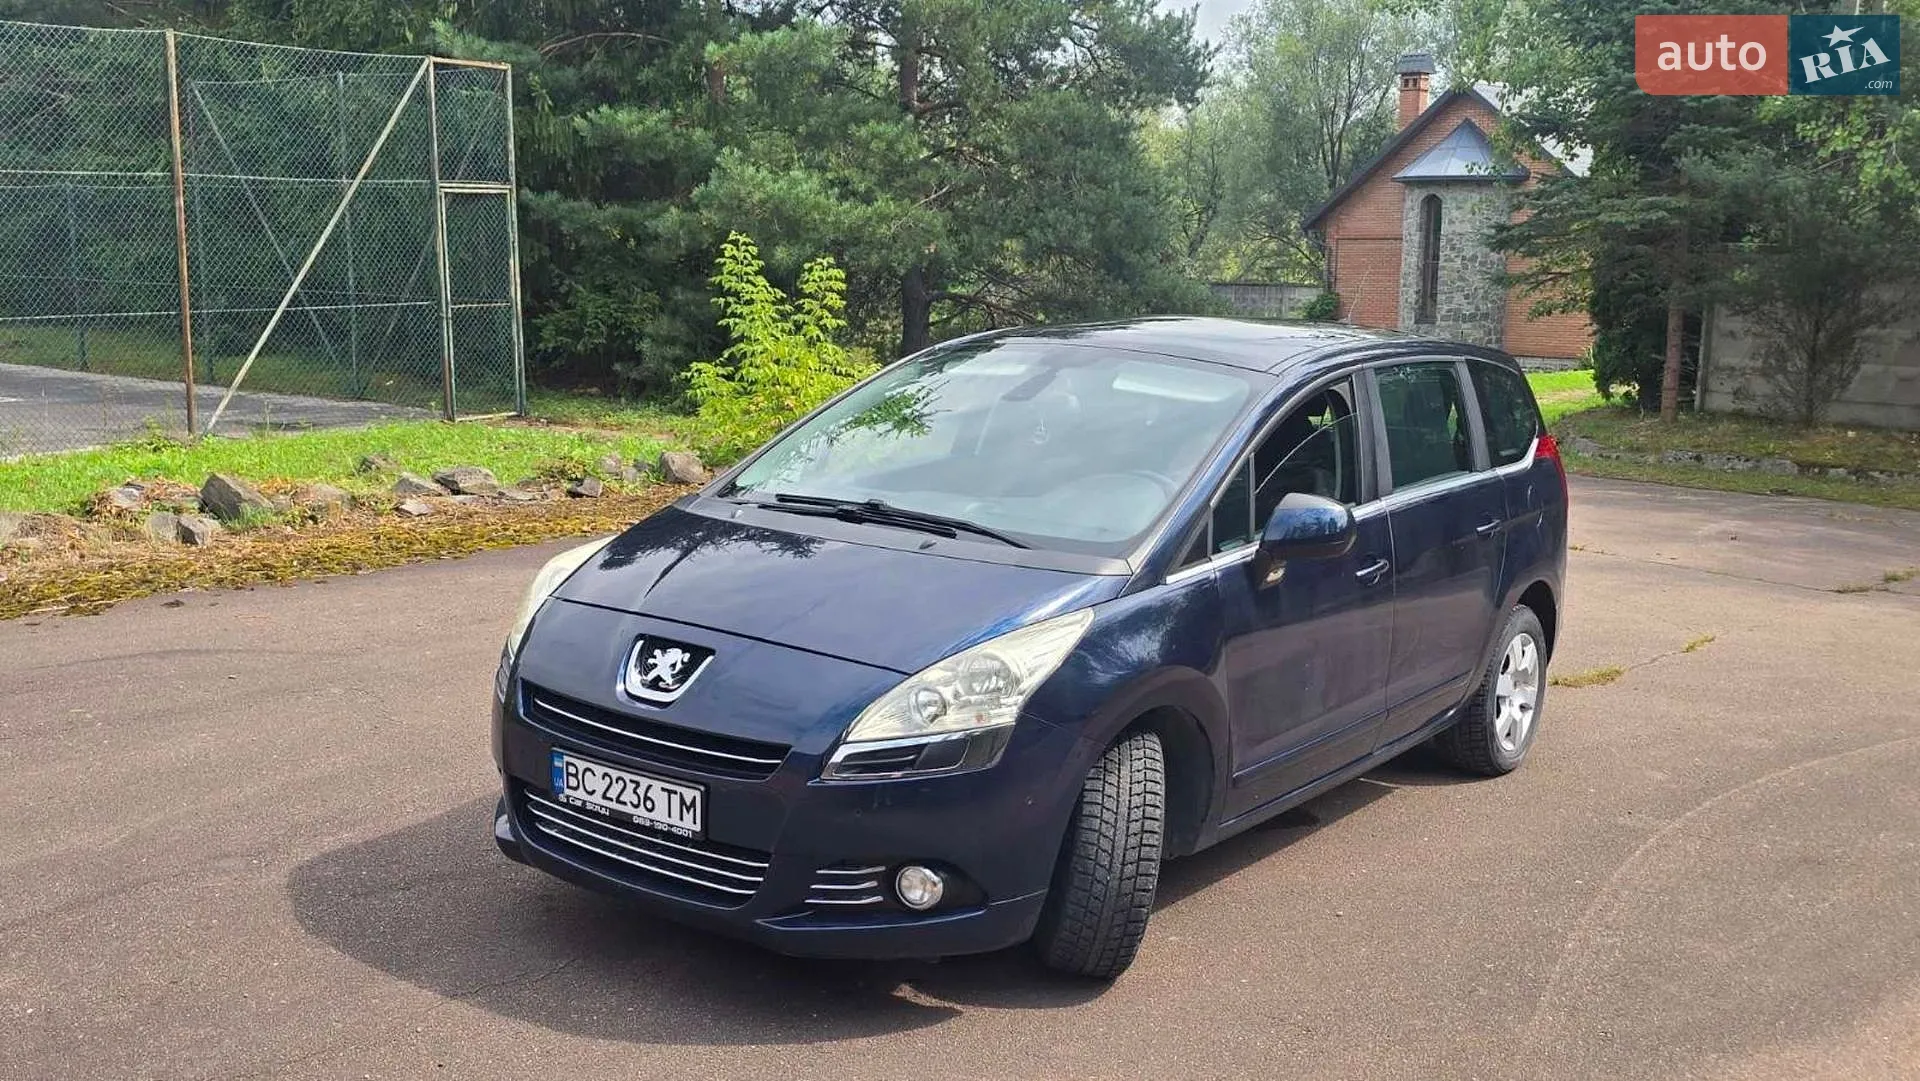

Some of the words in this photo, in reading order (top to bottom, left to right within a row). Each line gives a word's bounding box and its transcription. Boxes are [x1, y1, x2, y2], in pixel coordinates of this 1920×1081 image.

[553, 776, 564, 788] UA
[565, 760, 597, 796] BC
[601, 772, 656, 813] 2236
[661, 786, 697, 825] TM
